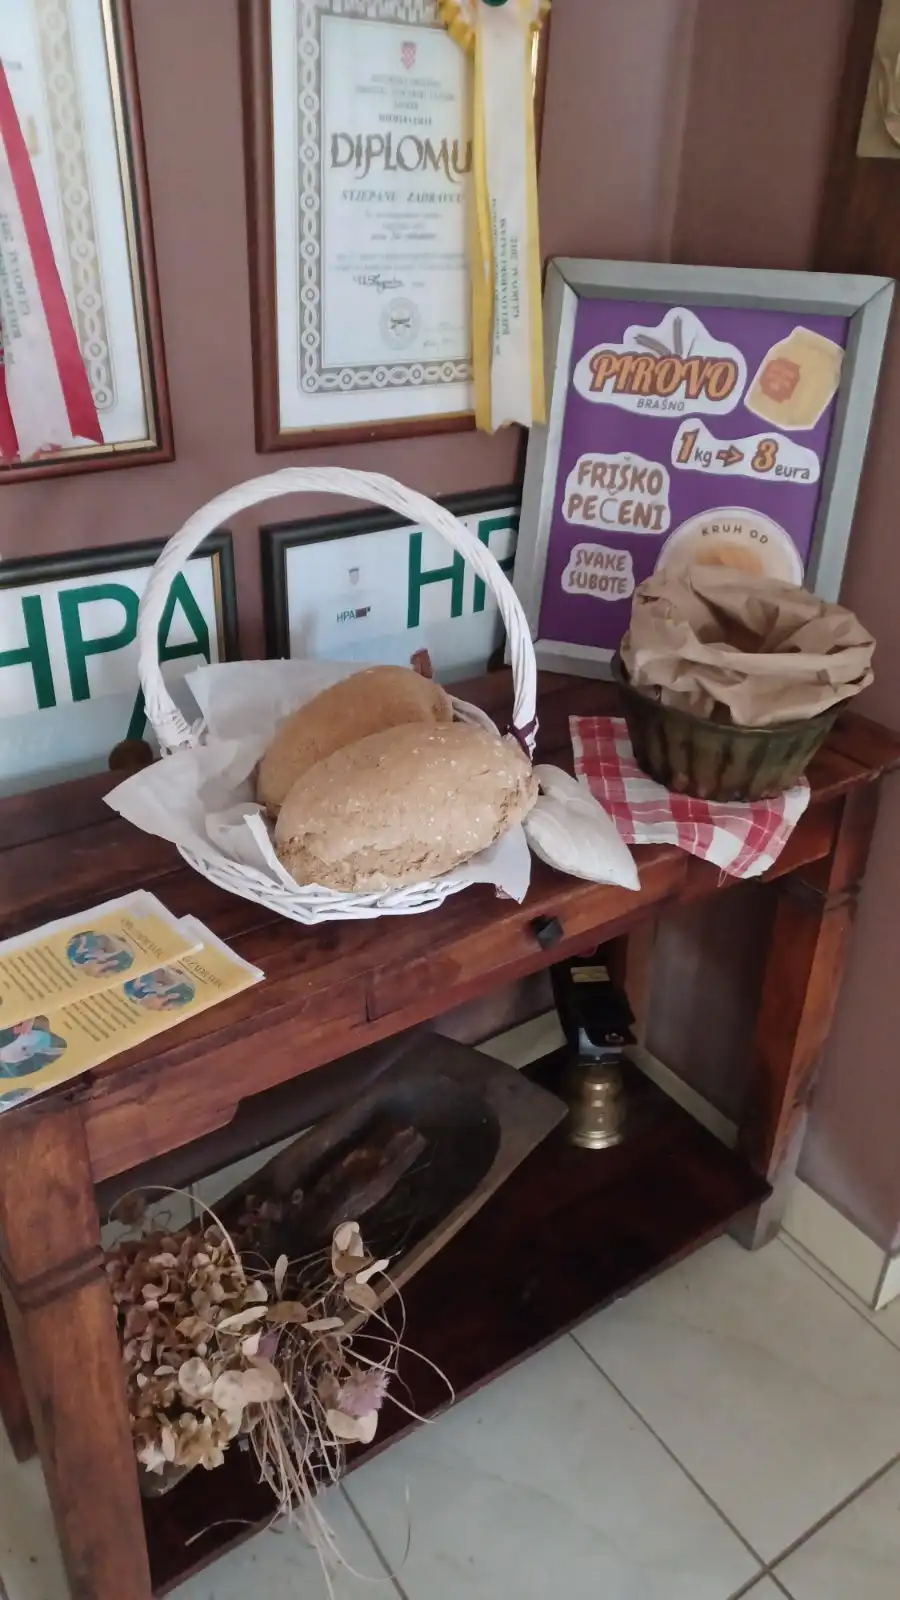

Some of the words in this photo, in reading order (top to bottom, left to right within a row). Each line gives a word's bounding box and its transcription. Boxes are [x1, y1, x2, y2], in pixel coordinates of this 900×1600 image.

[330, 131, 473, 183] DIPLOMU
[588, 349, 739, 402] PIROVO
[636, 398, 685, 412] BRAŠNO
[577, 456, 663, 496] FRIŠKO
[567, 489, 666, 530] PEČENI
[702, 524, 742, 536] KRUH
[750, 530, 769, 544] OD
[576, 550, 626, 572] SVAKE
[568, 570, 628, 594] SUBOTE
